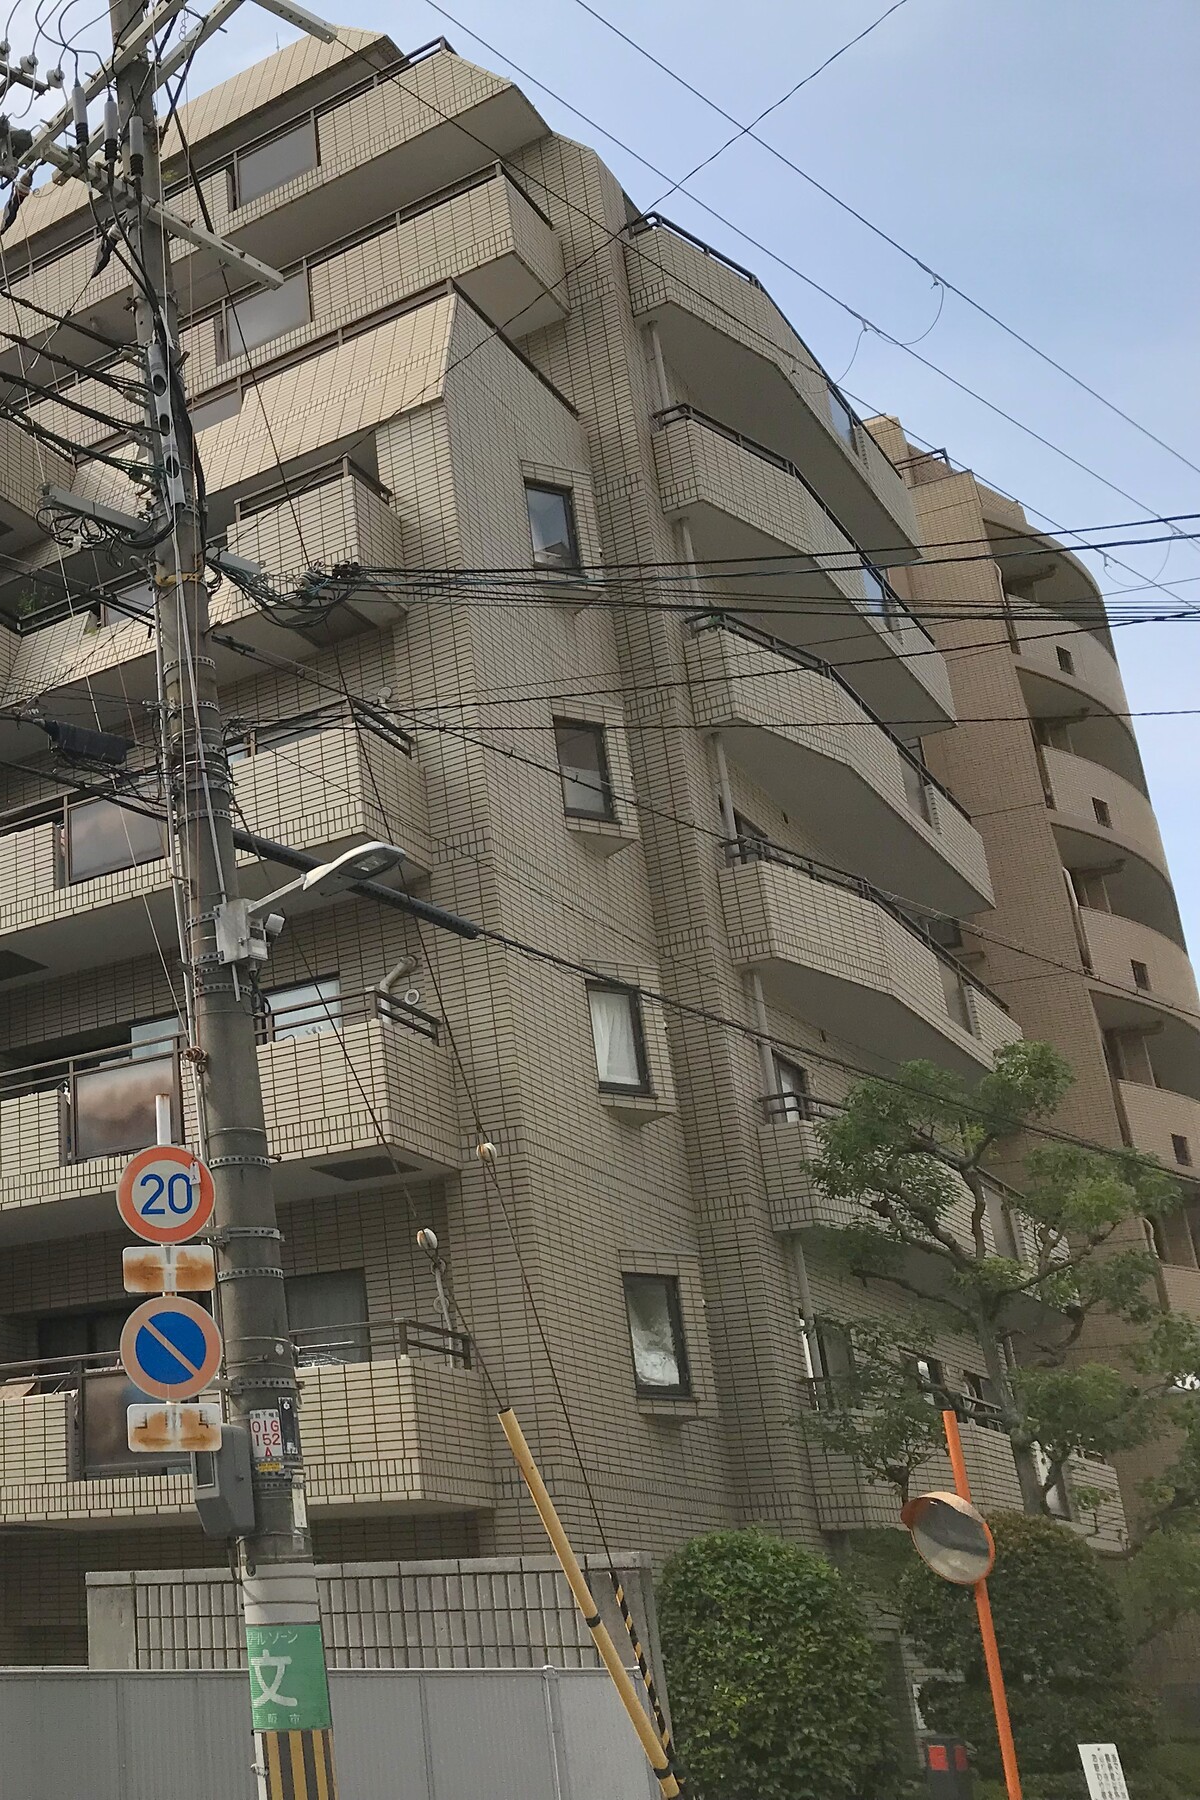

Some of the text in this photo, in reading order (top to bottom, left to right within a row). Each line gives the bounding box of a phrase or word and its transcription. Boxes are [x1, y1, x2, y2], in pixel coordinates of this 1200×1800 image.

[140, 1173, 193, 1215] 20
[255, 1433, 281, 1447] 152
[250, 1649, 298, 1708] 文
